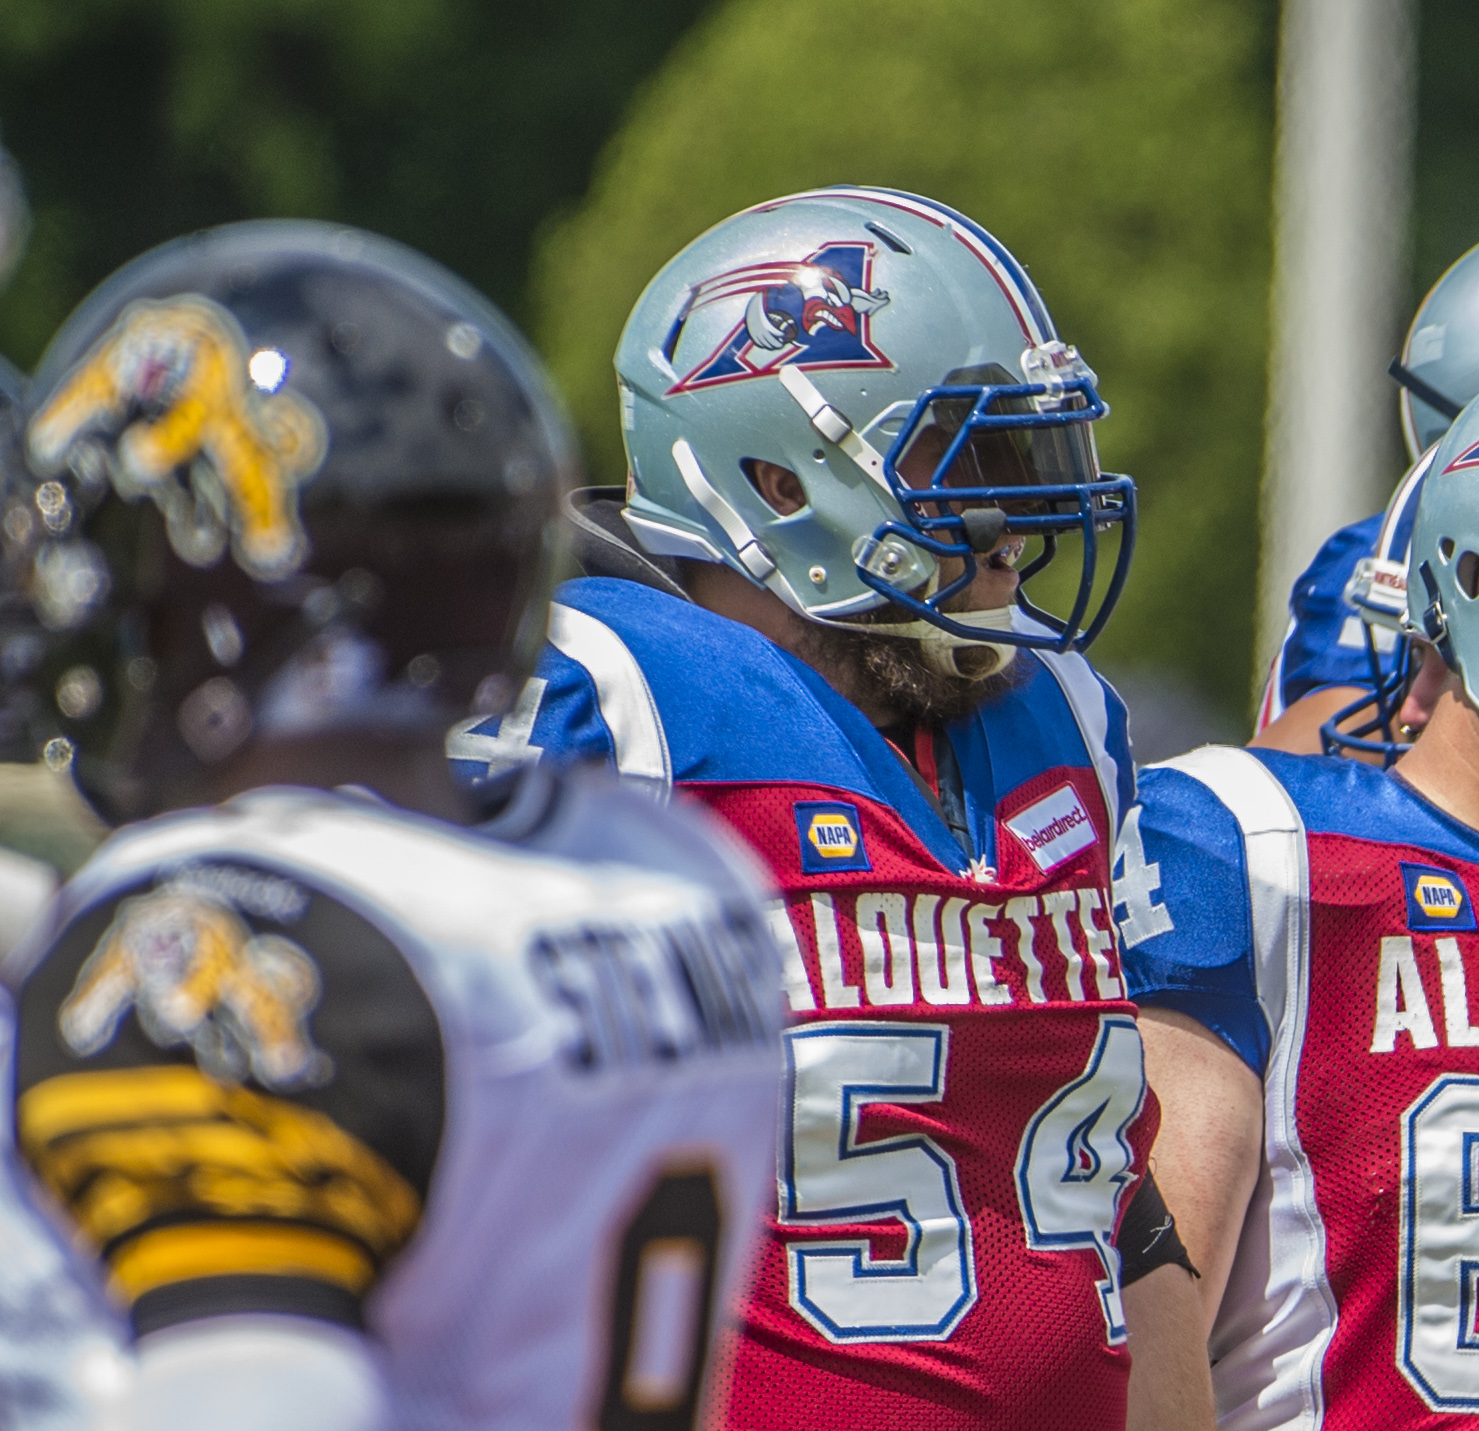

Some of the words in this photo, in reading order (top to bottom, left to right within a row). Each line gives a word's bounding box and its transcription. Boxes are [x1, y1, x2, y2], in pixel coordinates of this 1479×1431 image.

[816, 826, 853, 845] NAPA
[1422, 886, 1457, 906] NAPA
[763, 887, 1127, 1011] ALOUETTE
[777, 1018, 1140, 1346] 54
